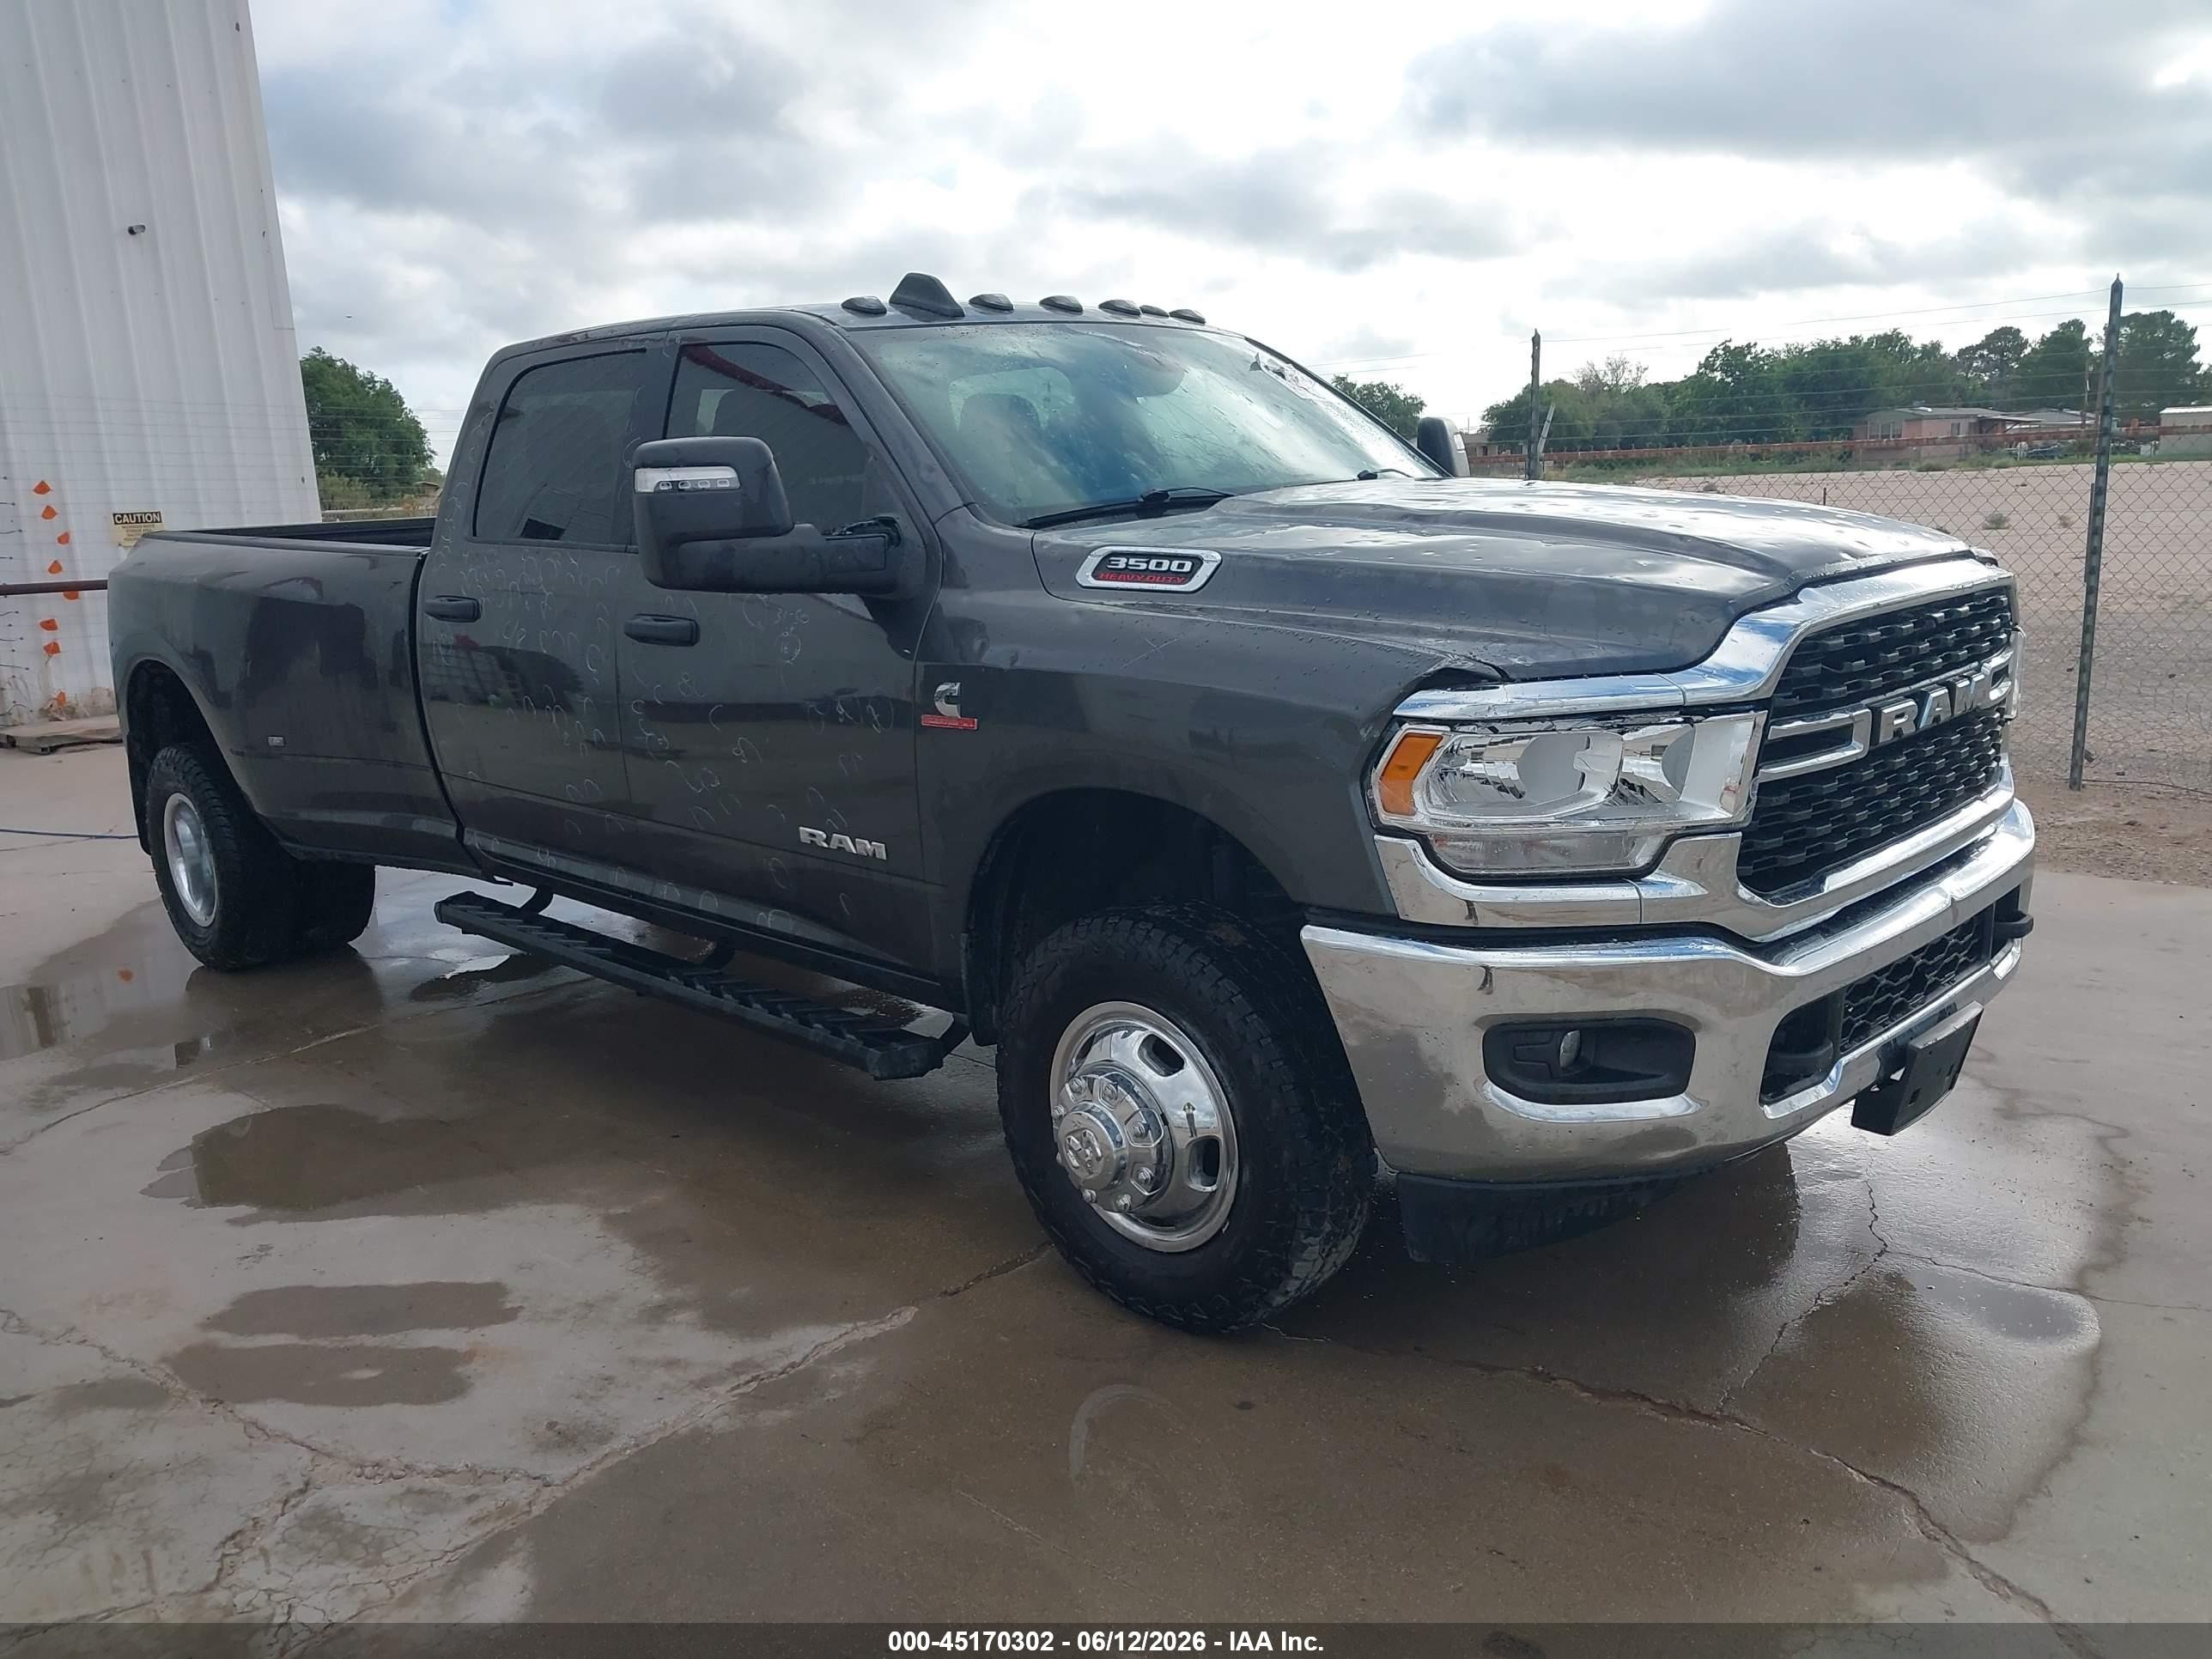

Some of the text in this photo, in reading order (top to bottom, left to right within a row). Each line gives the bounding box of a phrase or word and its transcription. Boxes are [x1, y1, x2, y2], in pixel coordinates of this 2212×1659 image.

[114, 513, 161, 523] CAUTION
[1107, 556, 1193, 572] 3500
[1099, 573, 1146, 581] HEAVY
[1879, 672, 1986, 744] RAM
[799, 826, 887, 860] RAM
